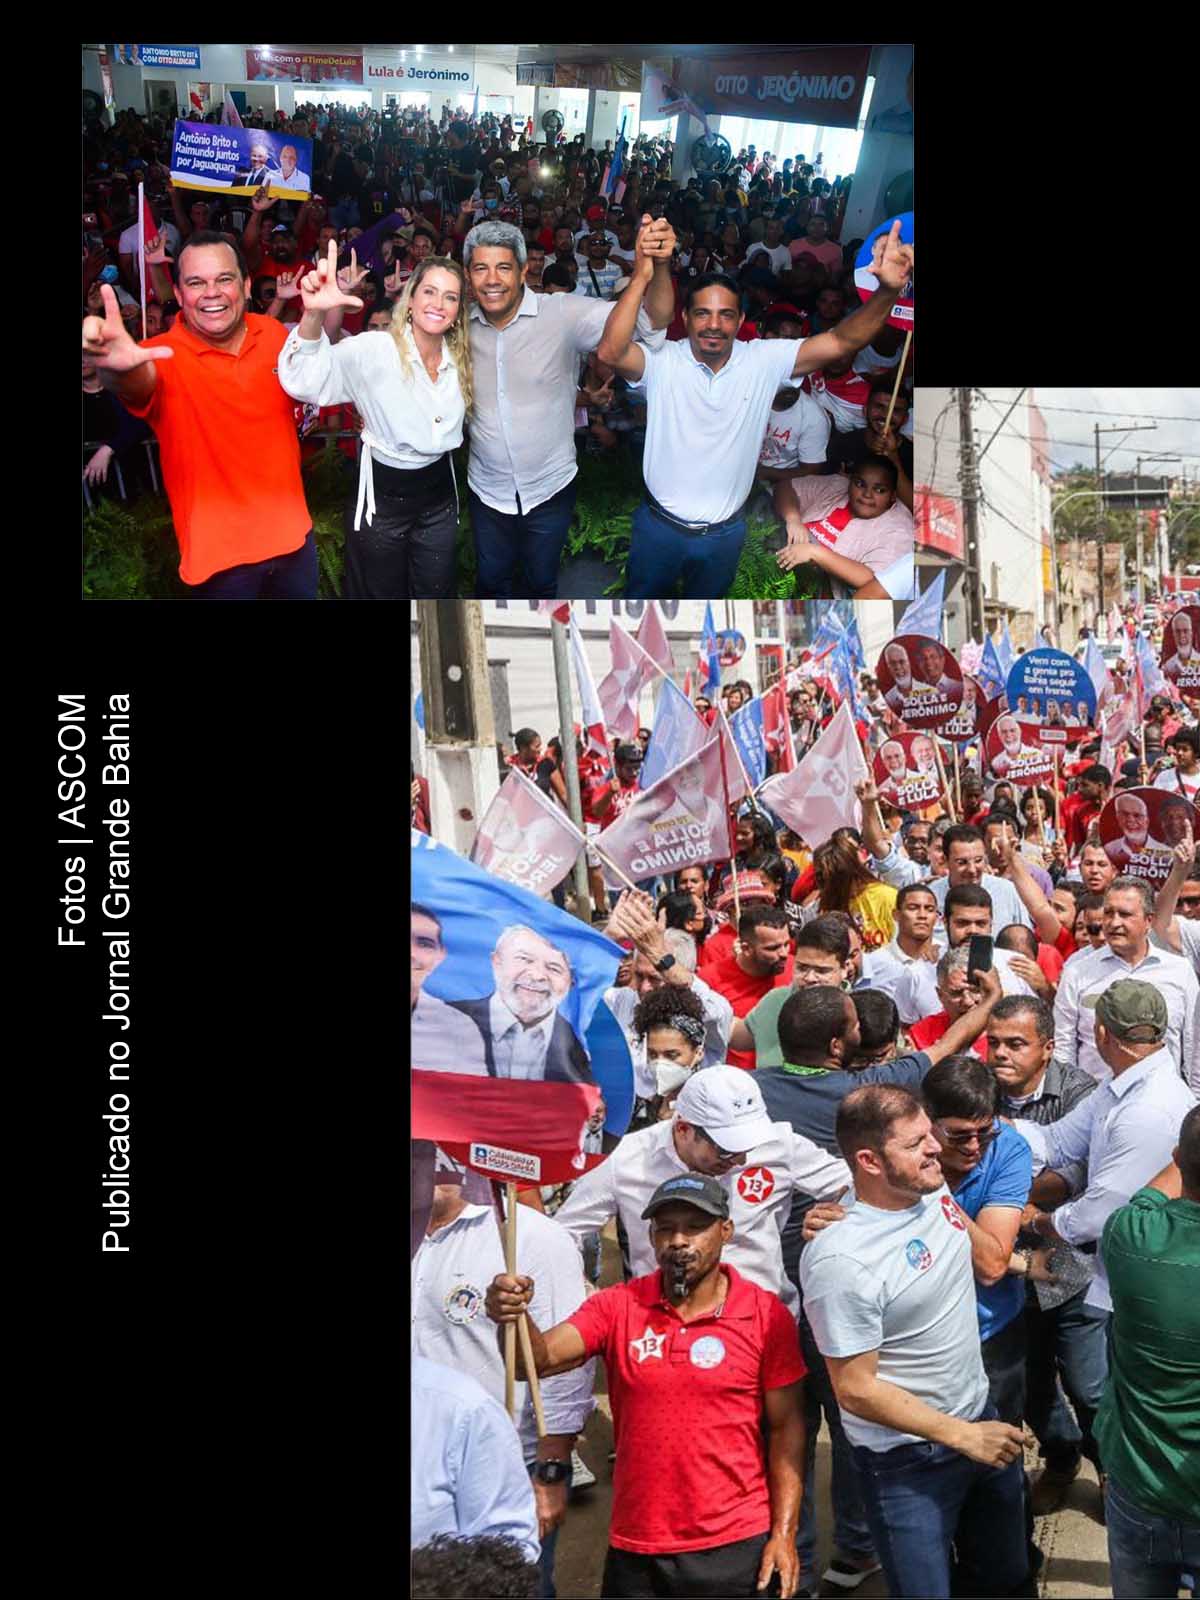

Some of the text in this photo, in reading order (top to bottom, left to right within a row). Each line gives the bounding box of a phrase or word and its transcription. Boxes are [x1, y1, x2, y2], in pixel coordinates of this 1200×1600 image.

[275, 55, 293, 63] com
[368, 65, 470, 81] Lula é Jerônimo
[715, 70, 856, 103] OTTO JERÔNIMO
[179, 131, 238, 148] Antônio Brito e
[175, 142, 240, 161] Raimundo juntos
[176, 157, 236, 173] por Jaguaquara
[1028, 656, 1049, 665] Vem
[902, 693, 948, 707] SOLLA E
[901, 702, 958, 720] JERÔNIMO
[1008, 756, 1042, 768] SOLLA
[1005, 763, 1055, 779] JERÔNIMO
[907, 787, 940, 804] LULA
[1121, 862, 1170, 880] JERÔN
[748, 1179, 763, 1193] 13
[641, 1337, 657, 1353] 13
